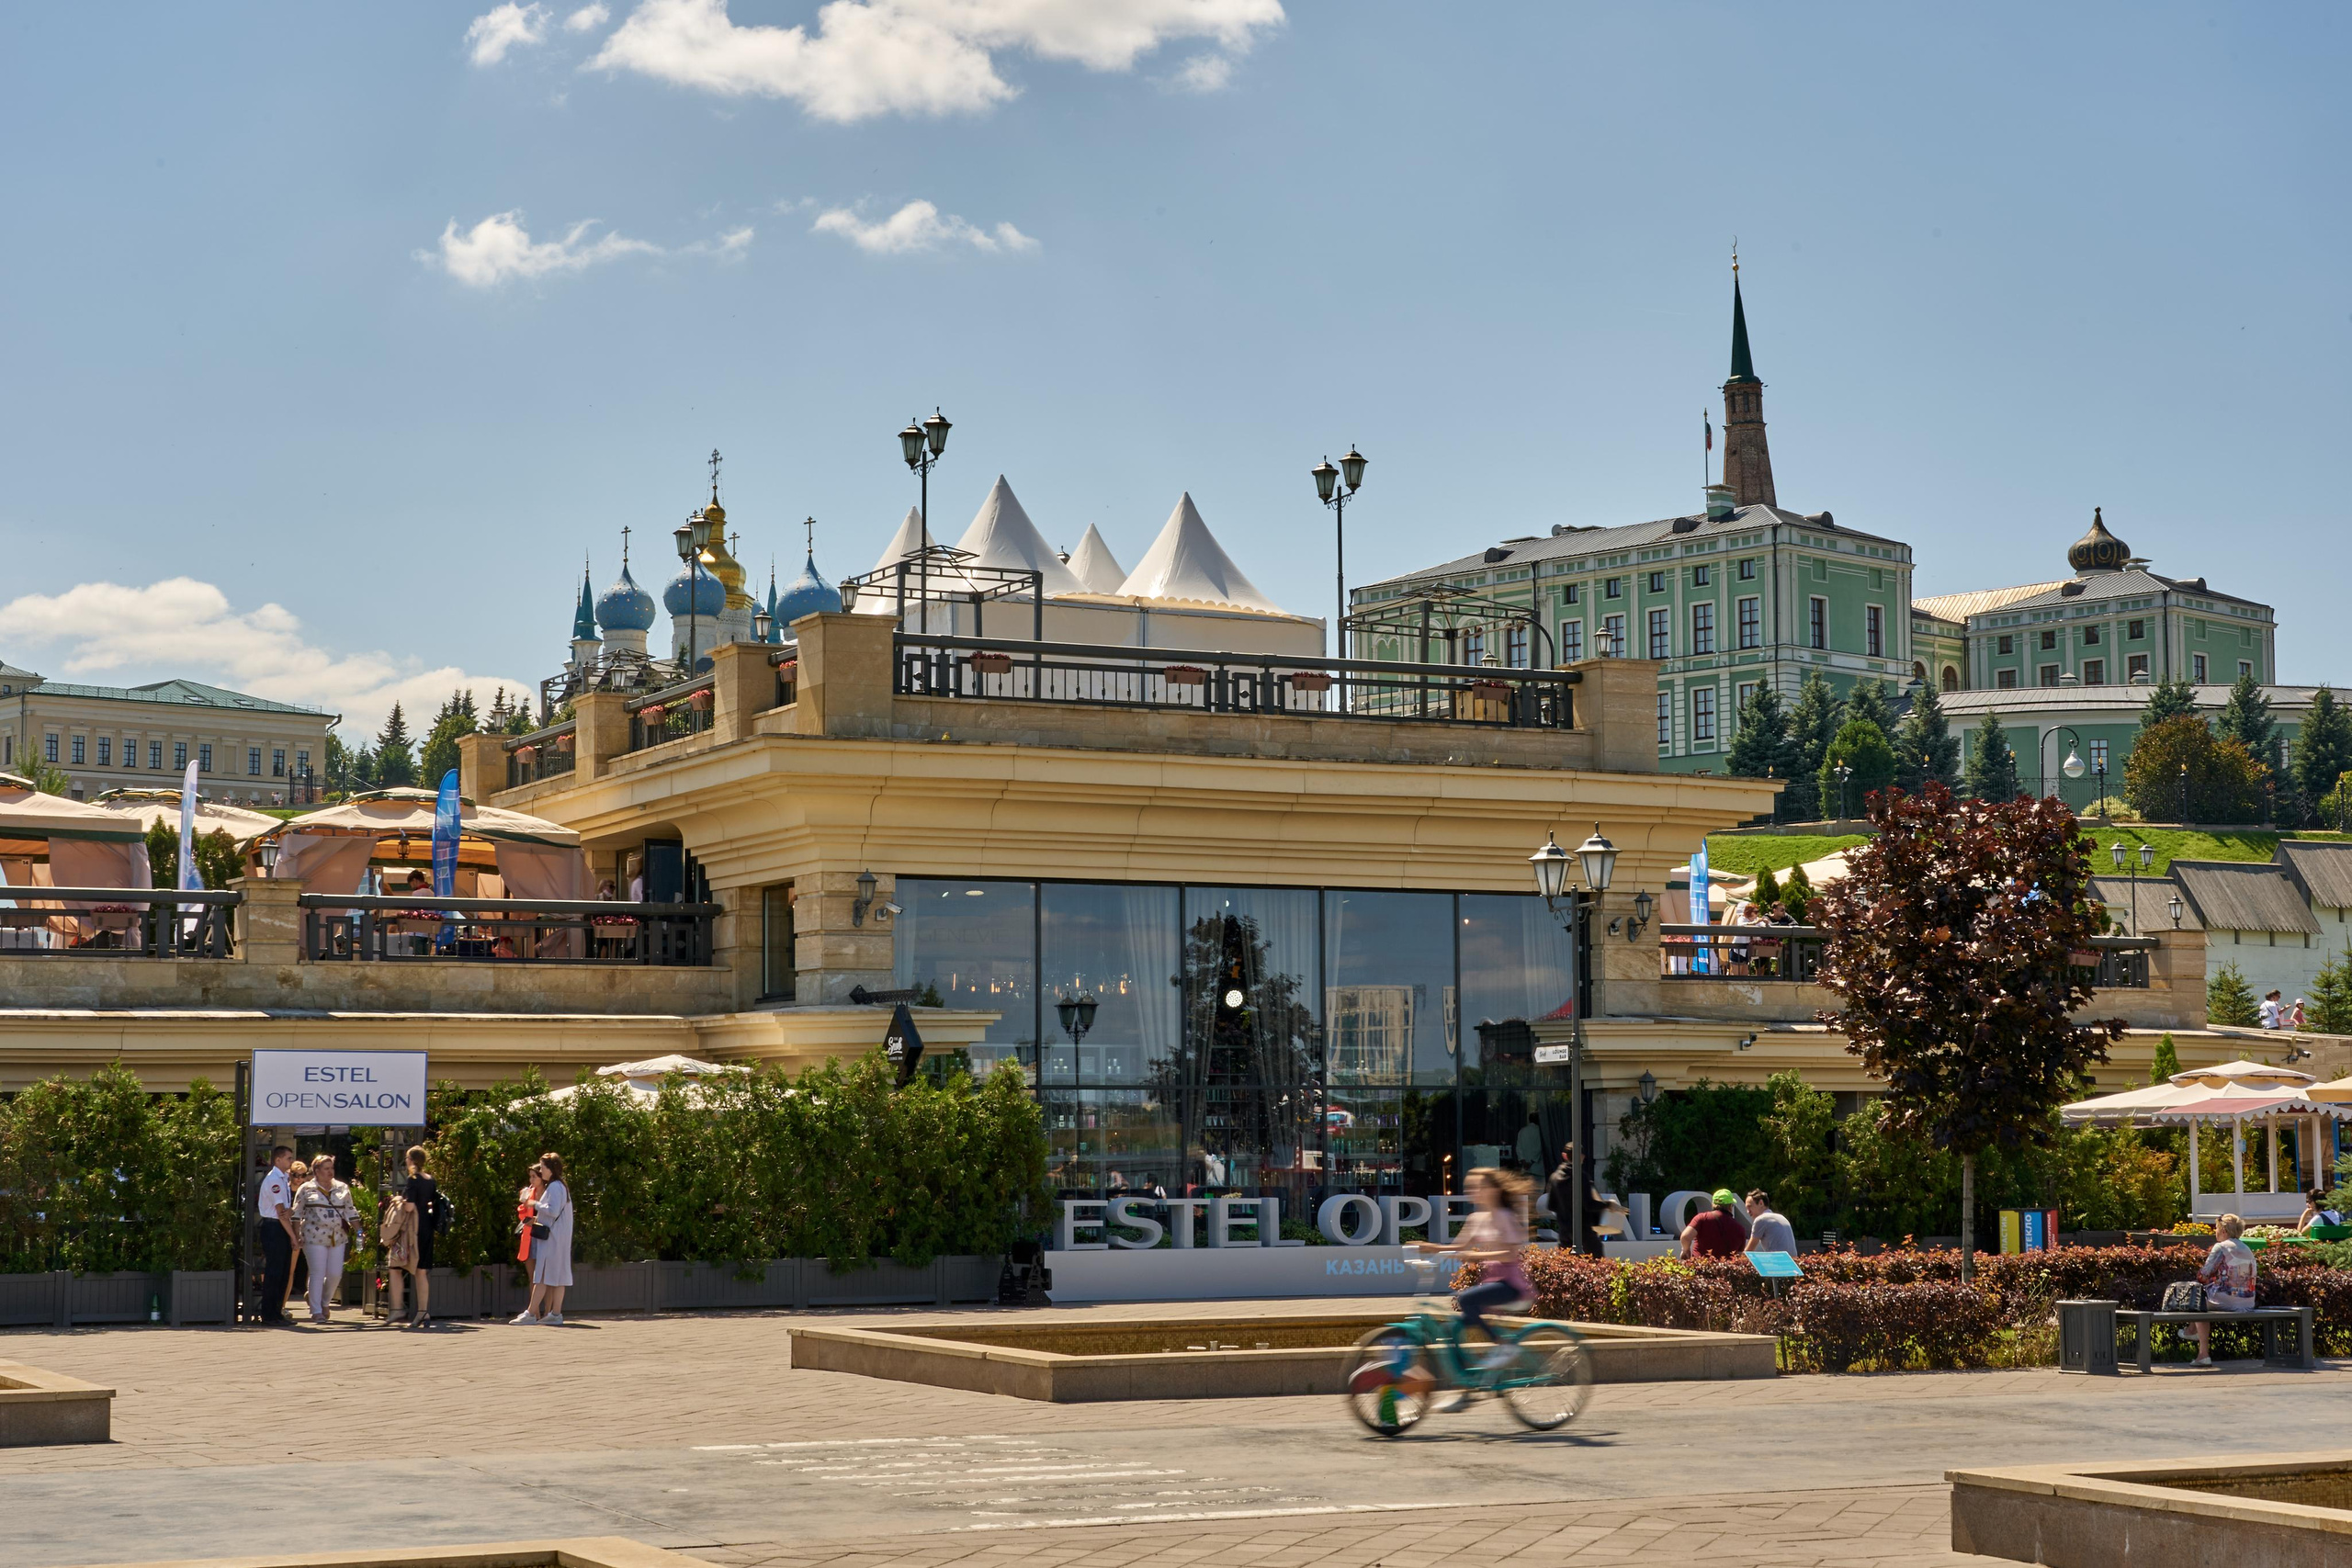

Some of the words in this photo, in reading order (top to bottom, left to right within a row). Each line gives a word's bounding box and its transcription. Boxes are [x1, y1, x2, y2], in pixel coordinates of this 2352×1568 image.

[304, 1066, 378, 1083] ESTEL
[266, 1092, 411, 1109] OPENSALON
[1054, 1197, 1306, 1250] ESTEL
[1326, 1258, 1406, 1276] КАЗАНЬ
